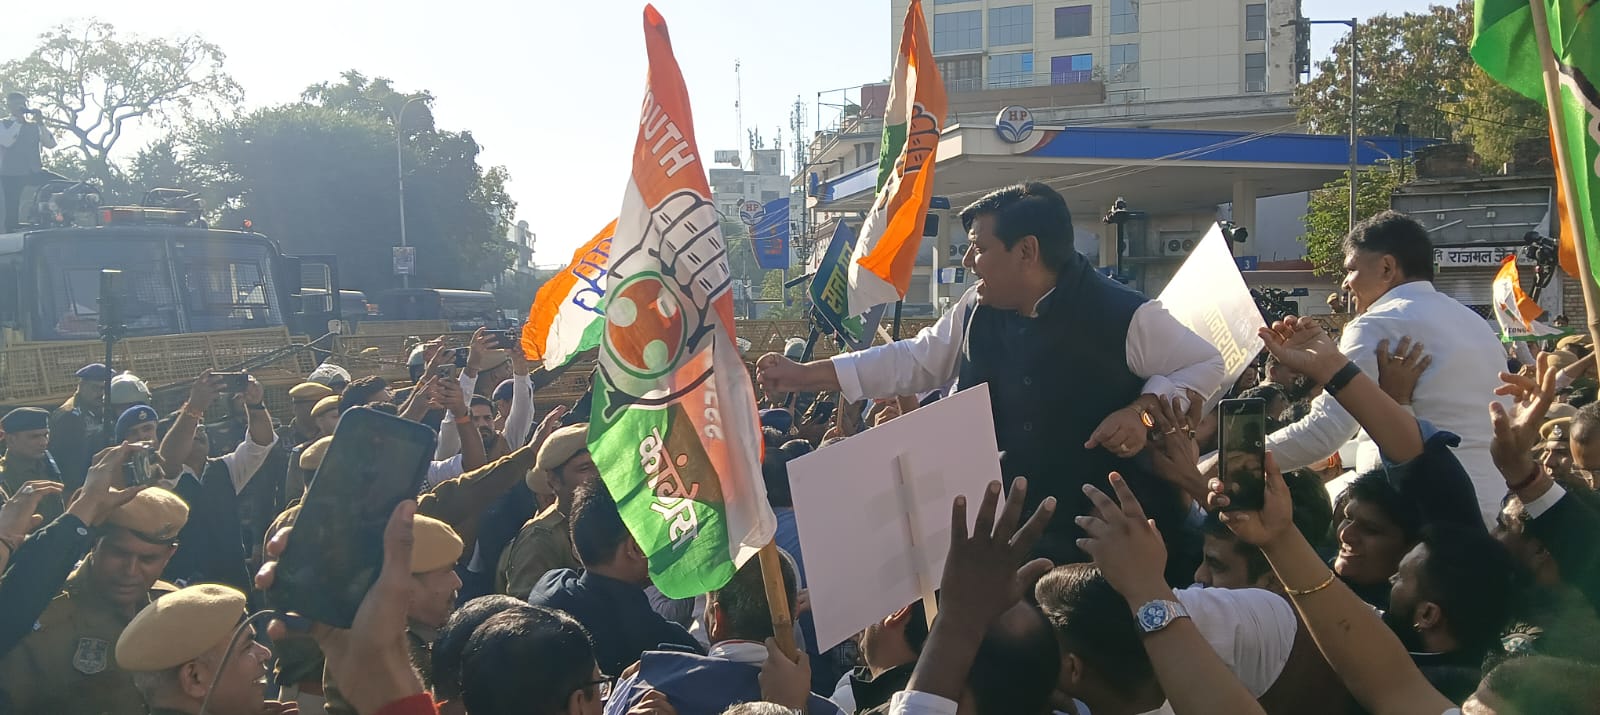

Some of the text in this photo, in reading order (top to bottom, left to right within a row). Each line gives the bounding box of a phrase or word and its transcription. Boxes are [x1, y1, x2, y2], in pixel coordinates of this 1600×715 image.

[1009, 110, 1028, 121] HP
[640, 90, 696, 178] OUTH
[745, 203, 759, 212] HP
[1447, 250, 1493, 263] राजमल
[1494, 247, 1517, 263] जै
[1244, 259, 1251, 270] 3
[639, 426, 699, 551] कांग्रेस
